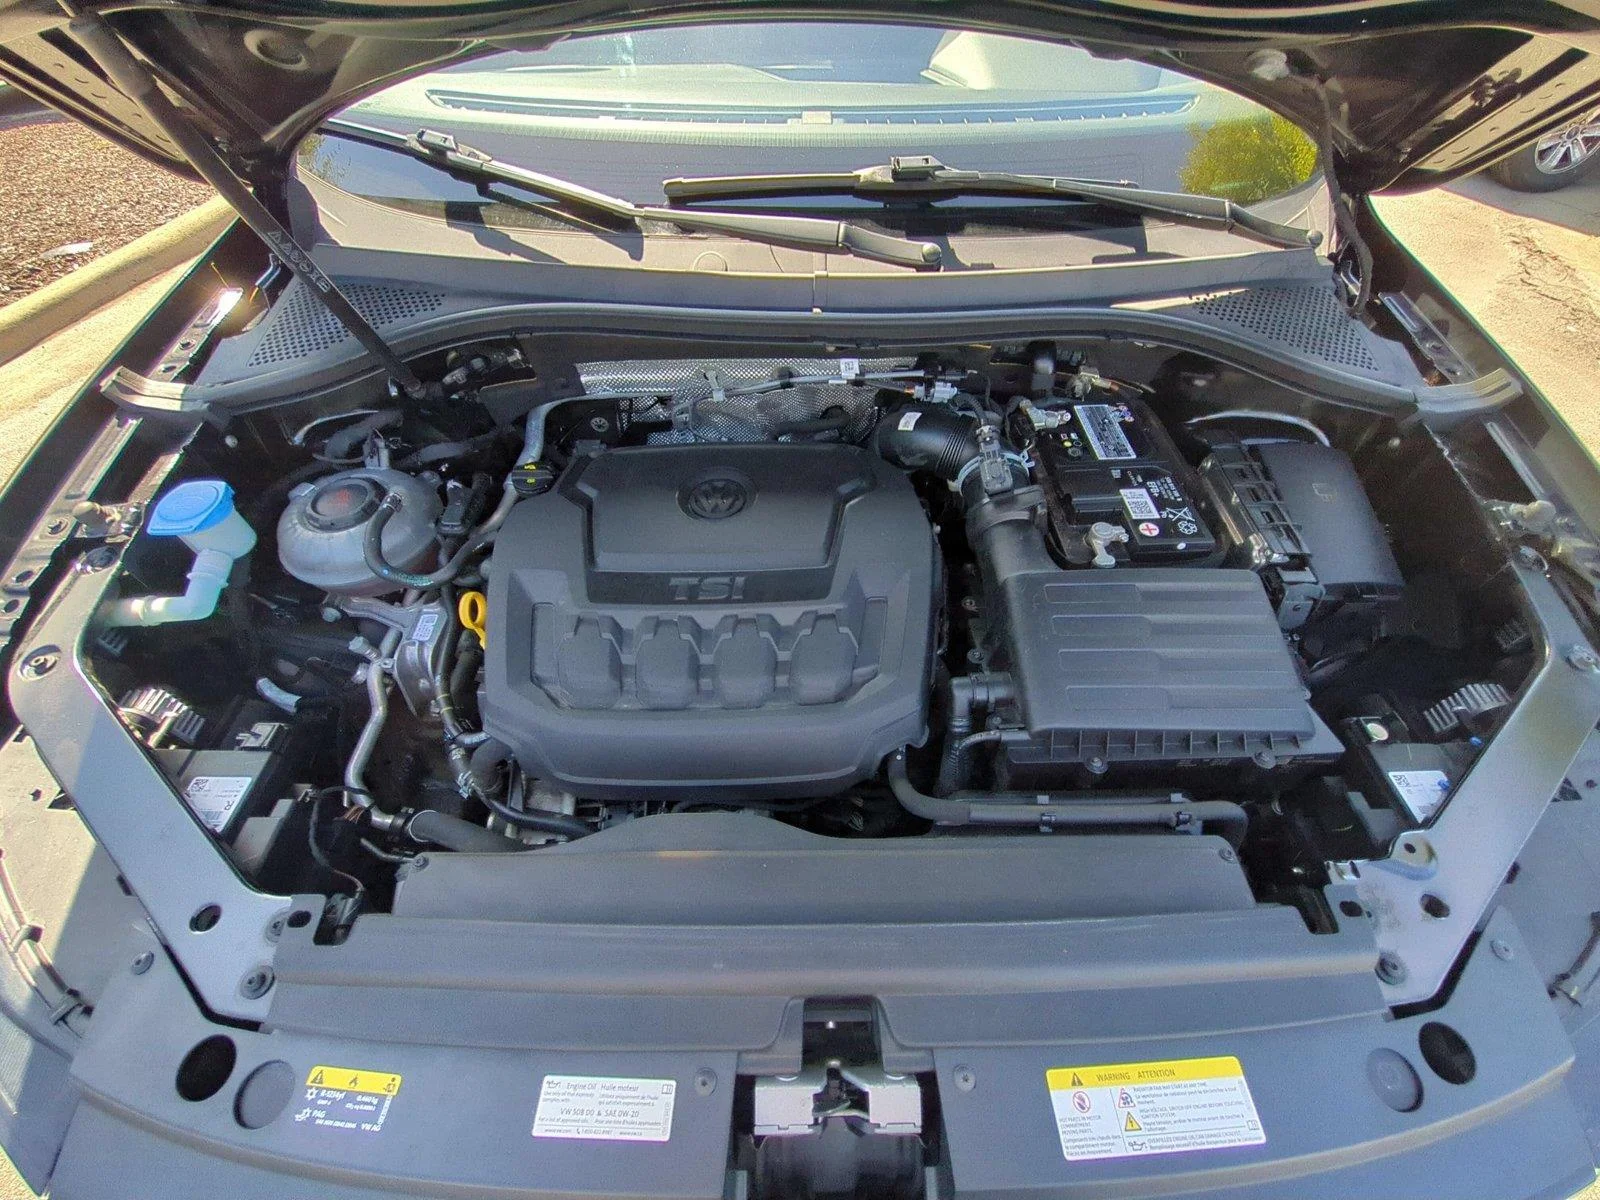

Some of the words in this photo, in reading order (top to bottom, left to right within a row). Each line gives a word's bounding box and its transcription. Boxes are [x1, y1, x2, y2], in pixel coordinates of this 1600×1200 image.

[669, 576, 746, 601] TSI
[1096, 1072, 1131, 1081] WARNING
[1137, 1069, 1176, 1079] ATTENTION
[566, 1082, 586, 1090] Engine
[312, 1109, 326, 1118] PAG
[604, 1108, 616, 1116] SAE
[361, 1123, 373, 1131] VW
[370, 1124, 381, 1132] AG
